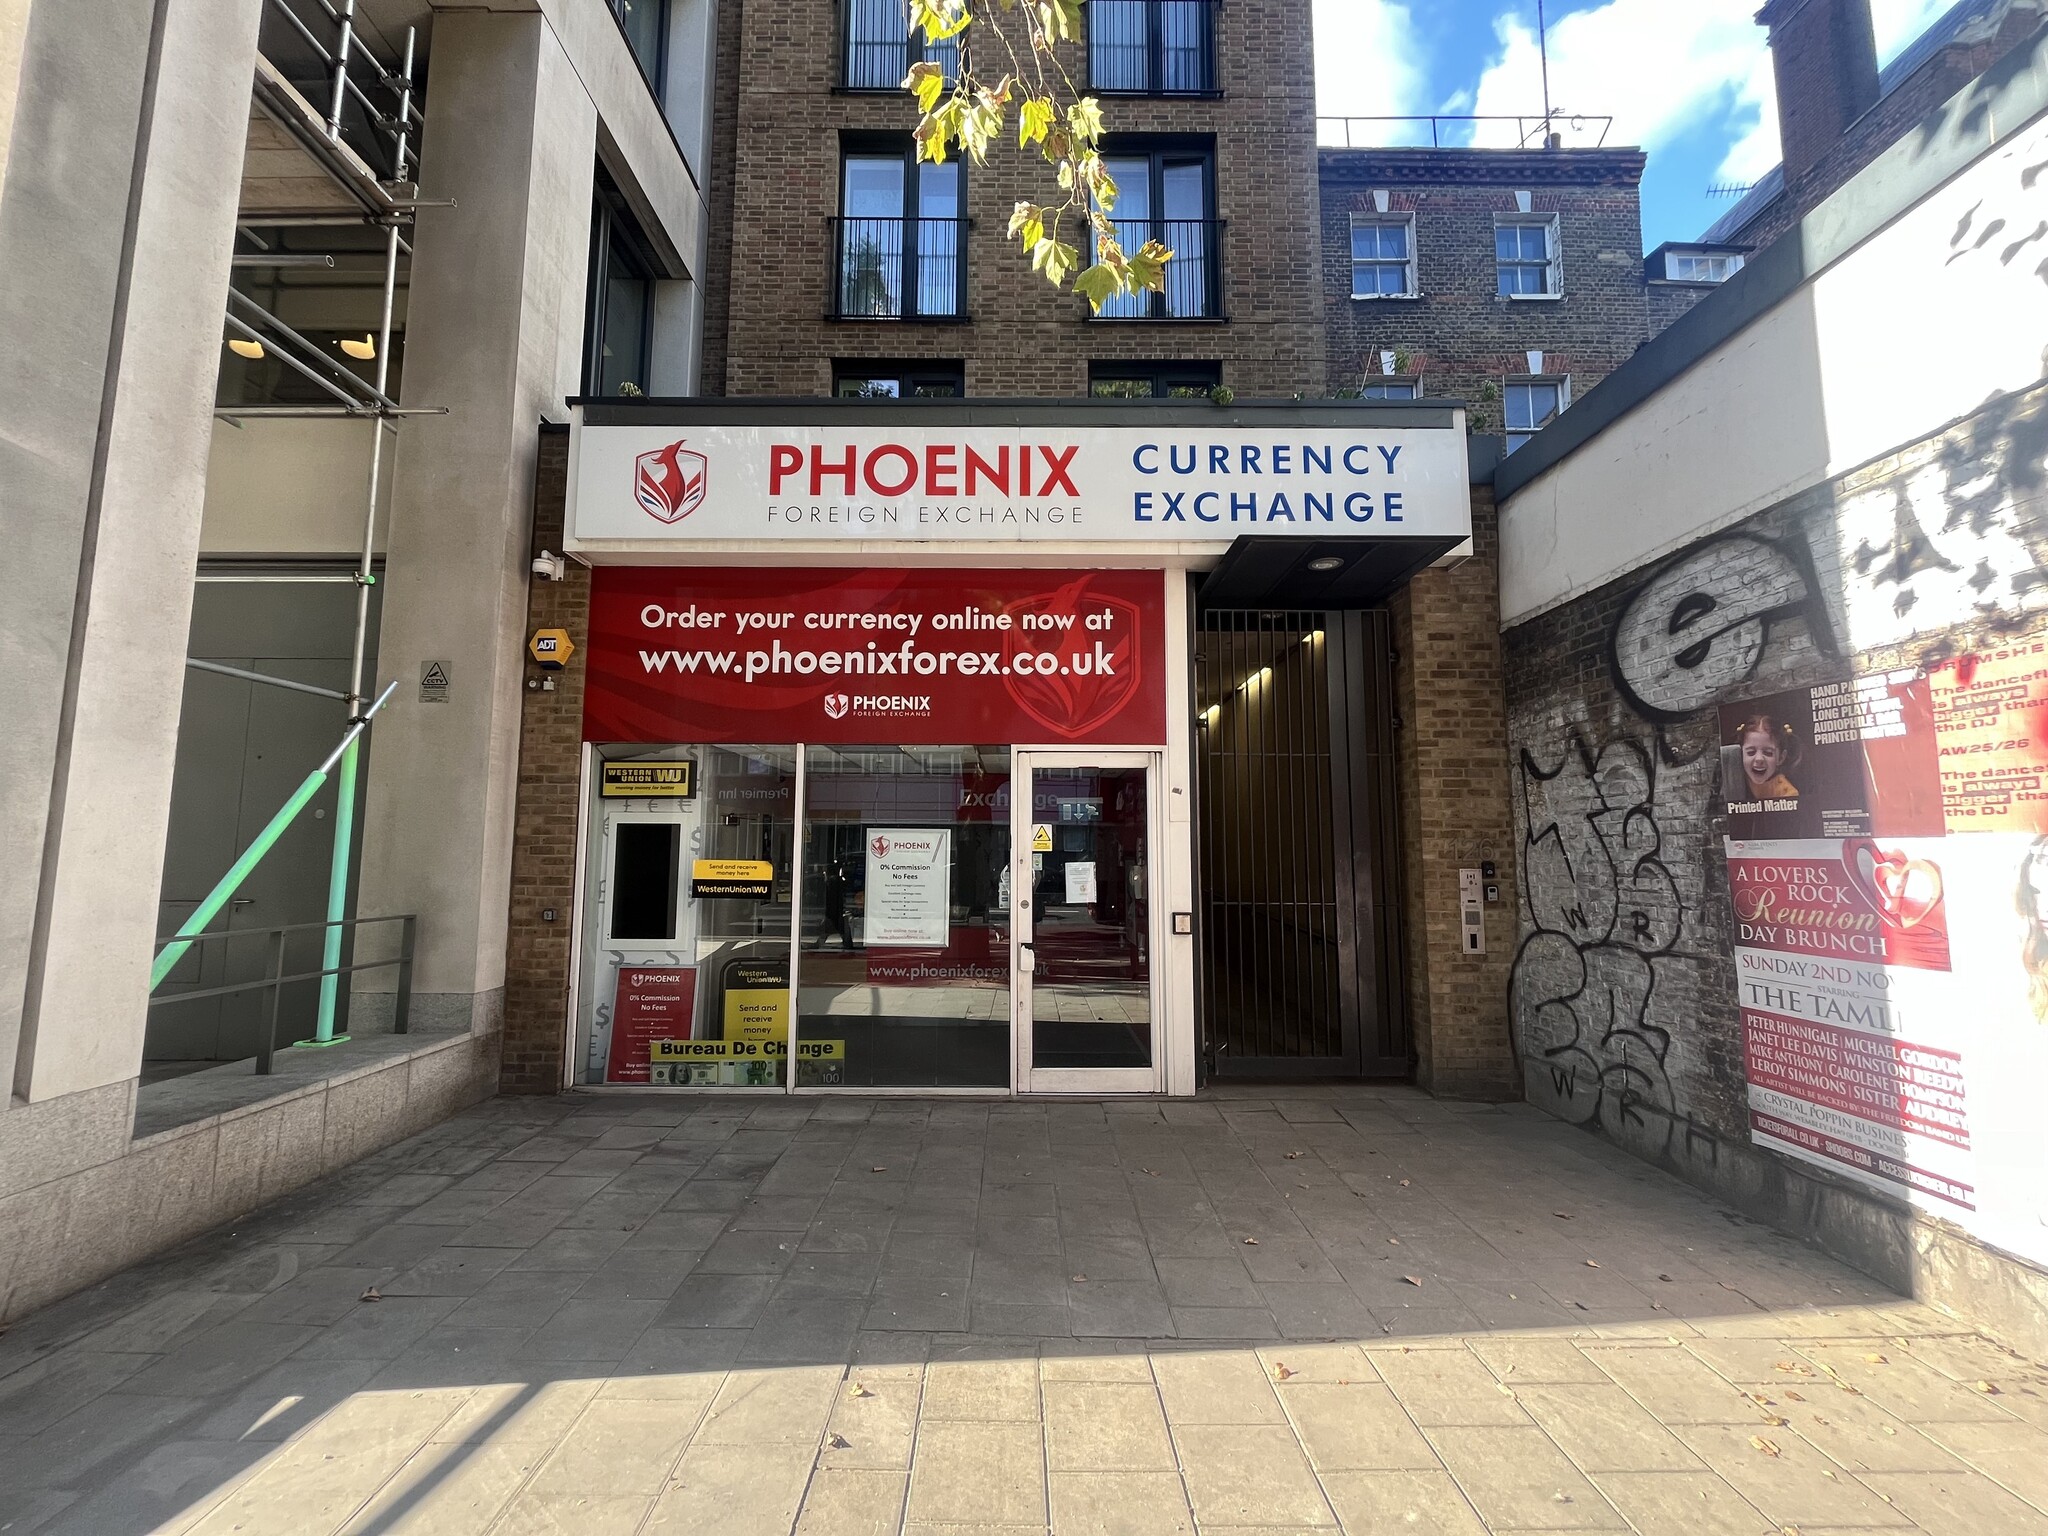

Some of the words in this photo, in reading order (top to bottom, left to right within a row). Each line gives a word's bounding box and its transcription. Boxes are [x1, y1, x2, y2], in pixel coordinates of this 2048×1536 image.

[1132, 444, 1402, 475] CURRENCY
[769, 444, 1080, 498] PHOENIX
[768, 506, 897, 523] FOREIGN
[919, 506, 1082, 523] EXCHANGE
[1134, 492, 1403, 522] EXCHANGE
[641, 604, 726, 628] Order
[735, 612, 795, 634] your
[804, 612, 923, 635] currency
[932, 606, 1012, 630] online
[1022, 613, 1076, 630] now
[1085, 608, 1114, 630] at
[537, 639, 556, 650] ADT
[639, 639, 1115, 683] www.phoenixforex.co.uk
[1810, 683, 1838, 699] HAND
[1930, 686, 1966, 697] The
[1932, 701, 1947, 709] is
[1953, 687, 2025, 706] always
[853, 695, 931, 710] PHOENIX
[1812, 707, 1839, 722] LONG
[1841, 702, 1868, 718] PLAY
[1813, 714, 1875, 734] AUDIOPHILE
[1935, 723, 1967, 733] the
[1971, 717, 1997, 728] DJ
[1814, 729, 1858, 745] PRINTED
[1939, 738, 2030, 756] AW25/26
[655, 769, 682, 782] WU
[1941, 771, 1977, 780] The
[1981, 764, 2048, 777] dance
[1942, 785, 1958, 793] is
[1964, 779, 2037, 793] always
[960, 788, 1058, 808] Exchge
[1727, 800, 1763, 814] Printed
[1764, 798, 1799, 812] Matter
[1943, 794, 2008, 805] bigger
[1945, 808, 1977, 817] the
[1981, 805, 2008, 816] DJ
[894, 842, 931, 850] PHOENIX
[1447, 838, 1495, 862] 126
[1736, 866, 1749, 882] A
[1754, 866, 1828, 885] LOVERS
[697, 885, 752, 893] WesternUnion
[1787, 884, 1852, 904] ROCK
[1734, 886, 1881, 932] Reunion
[1740, 924, 1777, 943] DAY
[1785, 928, 1888, 956] BRUNCH
[645, 975, 680, 983] PHOENIX
[870, 963, 1049, 980] www.phoenixforexuk
[1742, 954, 1809, 978] SUNDAY
[1812, 963, 1852, 984] 2ND
[1857, 970, 1895, 990] NO
[1745, 983, 1802, 1012] THE
[1818, 985, 1860, 999] STARRING
[739, 1004, 760, 1012] Send
[761, 1004, 777, 1012] and
[743, 1014, 773, 1023] receive
[743, 1026, 772, 1035] money
[1747, 1014, 1776, 1032] PETER
[1776, 1020, 1839, 1047] HUNNIGALE
[1844, 1036, 1900, 1060] MICHAEL
[661, 1042, 726, 1055] Bureau
[732, 1041, 757, 1055] De
[763, 1041, 834, 1058] Chnge
[1748, 1028, 1779, 1047] JANET
[1781, 1036, 1800, 1052] LEE
[1802, 1041, 1838, 1061] DAVIS
[1844, 1051, 1911, 1080] WINSTON
[1749, 1043, 1773, 1060] MIKE
[1774, 1050, 1823, 1073] ANTHONY
[1828, 1063, 1889, 1091] CAROLENE
[822, 1074, 840, 1084] 100
[1752, 1057, 1786, 1077] LEROY
[1788, 1067, 1846, 1095] SIMMONS
[1854, 1085, 1901, 1111] SISTER
[1764, 1092, 1807, 1115] CRYSTAL
[1810, 1105, 1851, 1130] POPPIN
[1855, 1121, 1910, 1148] BUSINES
[1861, 1106, 1879, 1118] THE
